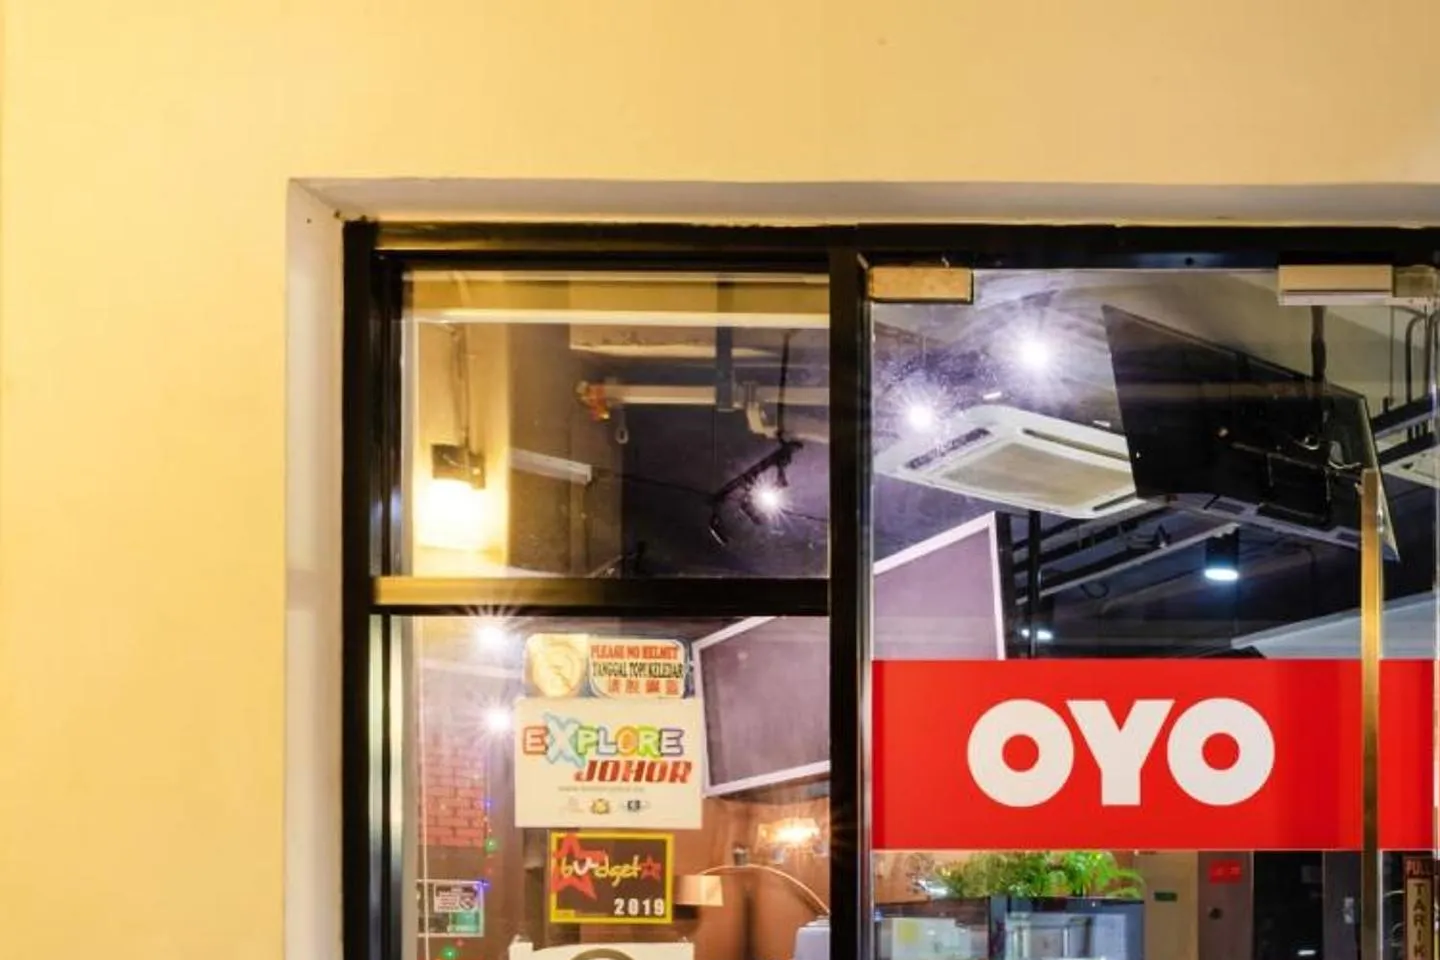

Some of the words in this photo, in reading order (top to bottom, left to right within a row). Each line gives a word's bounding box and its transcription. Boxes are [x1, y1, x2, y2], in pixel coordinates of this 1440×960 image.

[523, 713, 684, 767] EXPLORE
[967, 698, 1275, 807] OYO
[573, 760, 692, 783] JOHOR
[614, 898, 665, 916] 2019
[1413, 882, 1427, 958] TARIK
